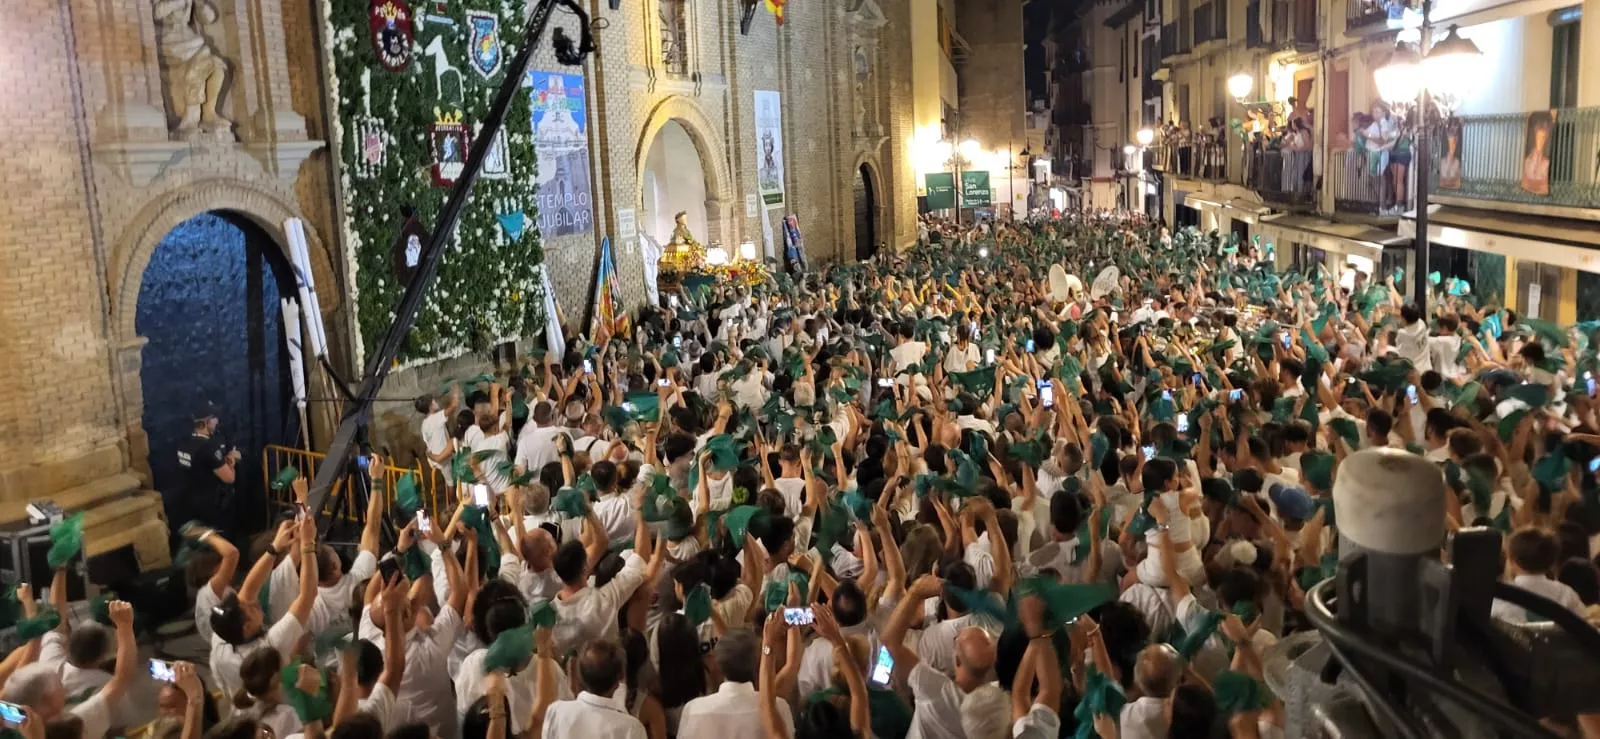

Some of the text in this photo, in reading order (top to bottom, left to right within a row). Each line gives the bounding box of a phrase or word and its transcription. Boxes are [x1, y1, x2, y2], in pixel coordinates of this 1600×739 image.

[965, 182, 977, 190] San
[539, 191, 587, 209] TEMPLO
[537, 210, 590, 229] JUBILAR
